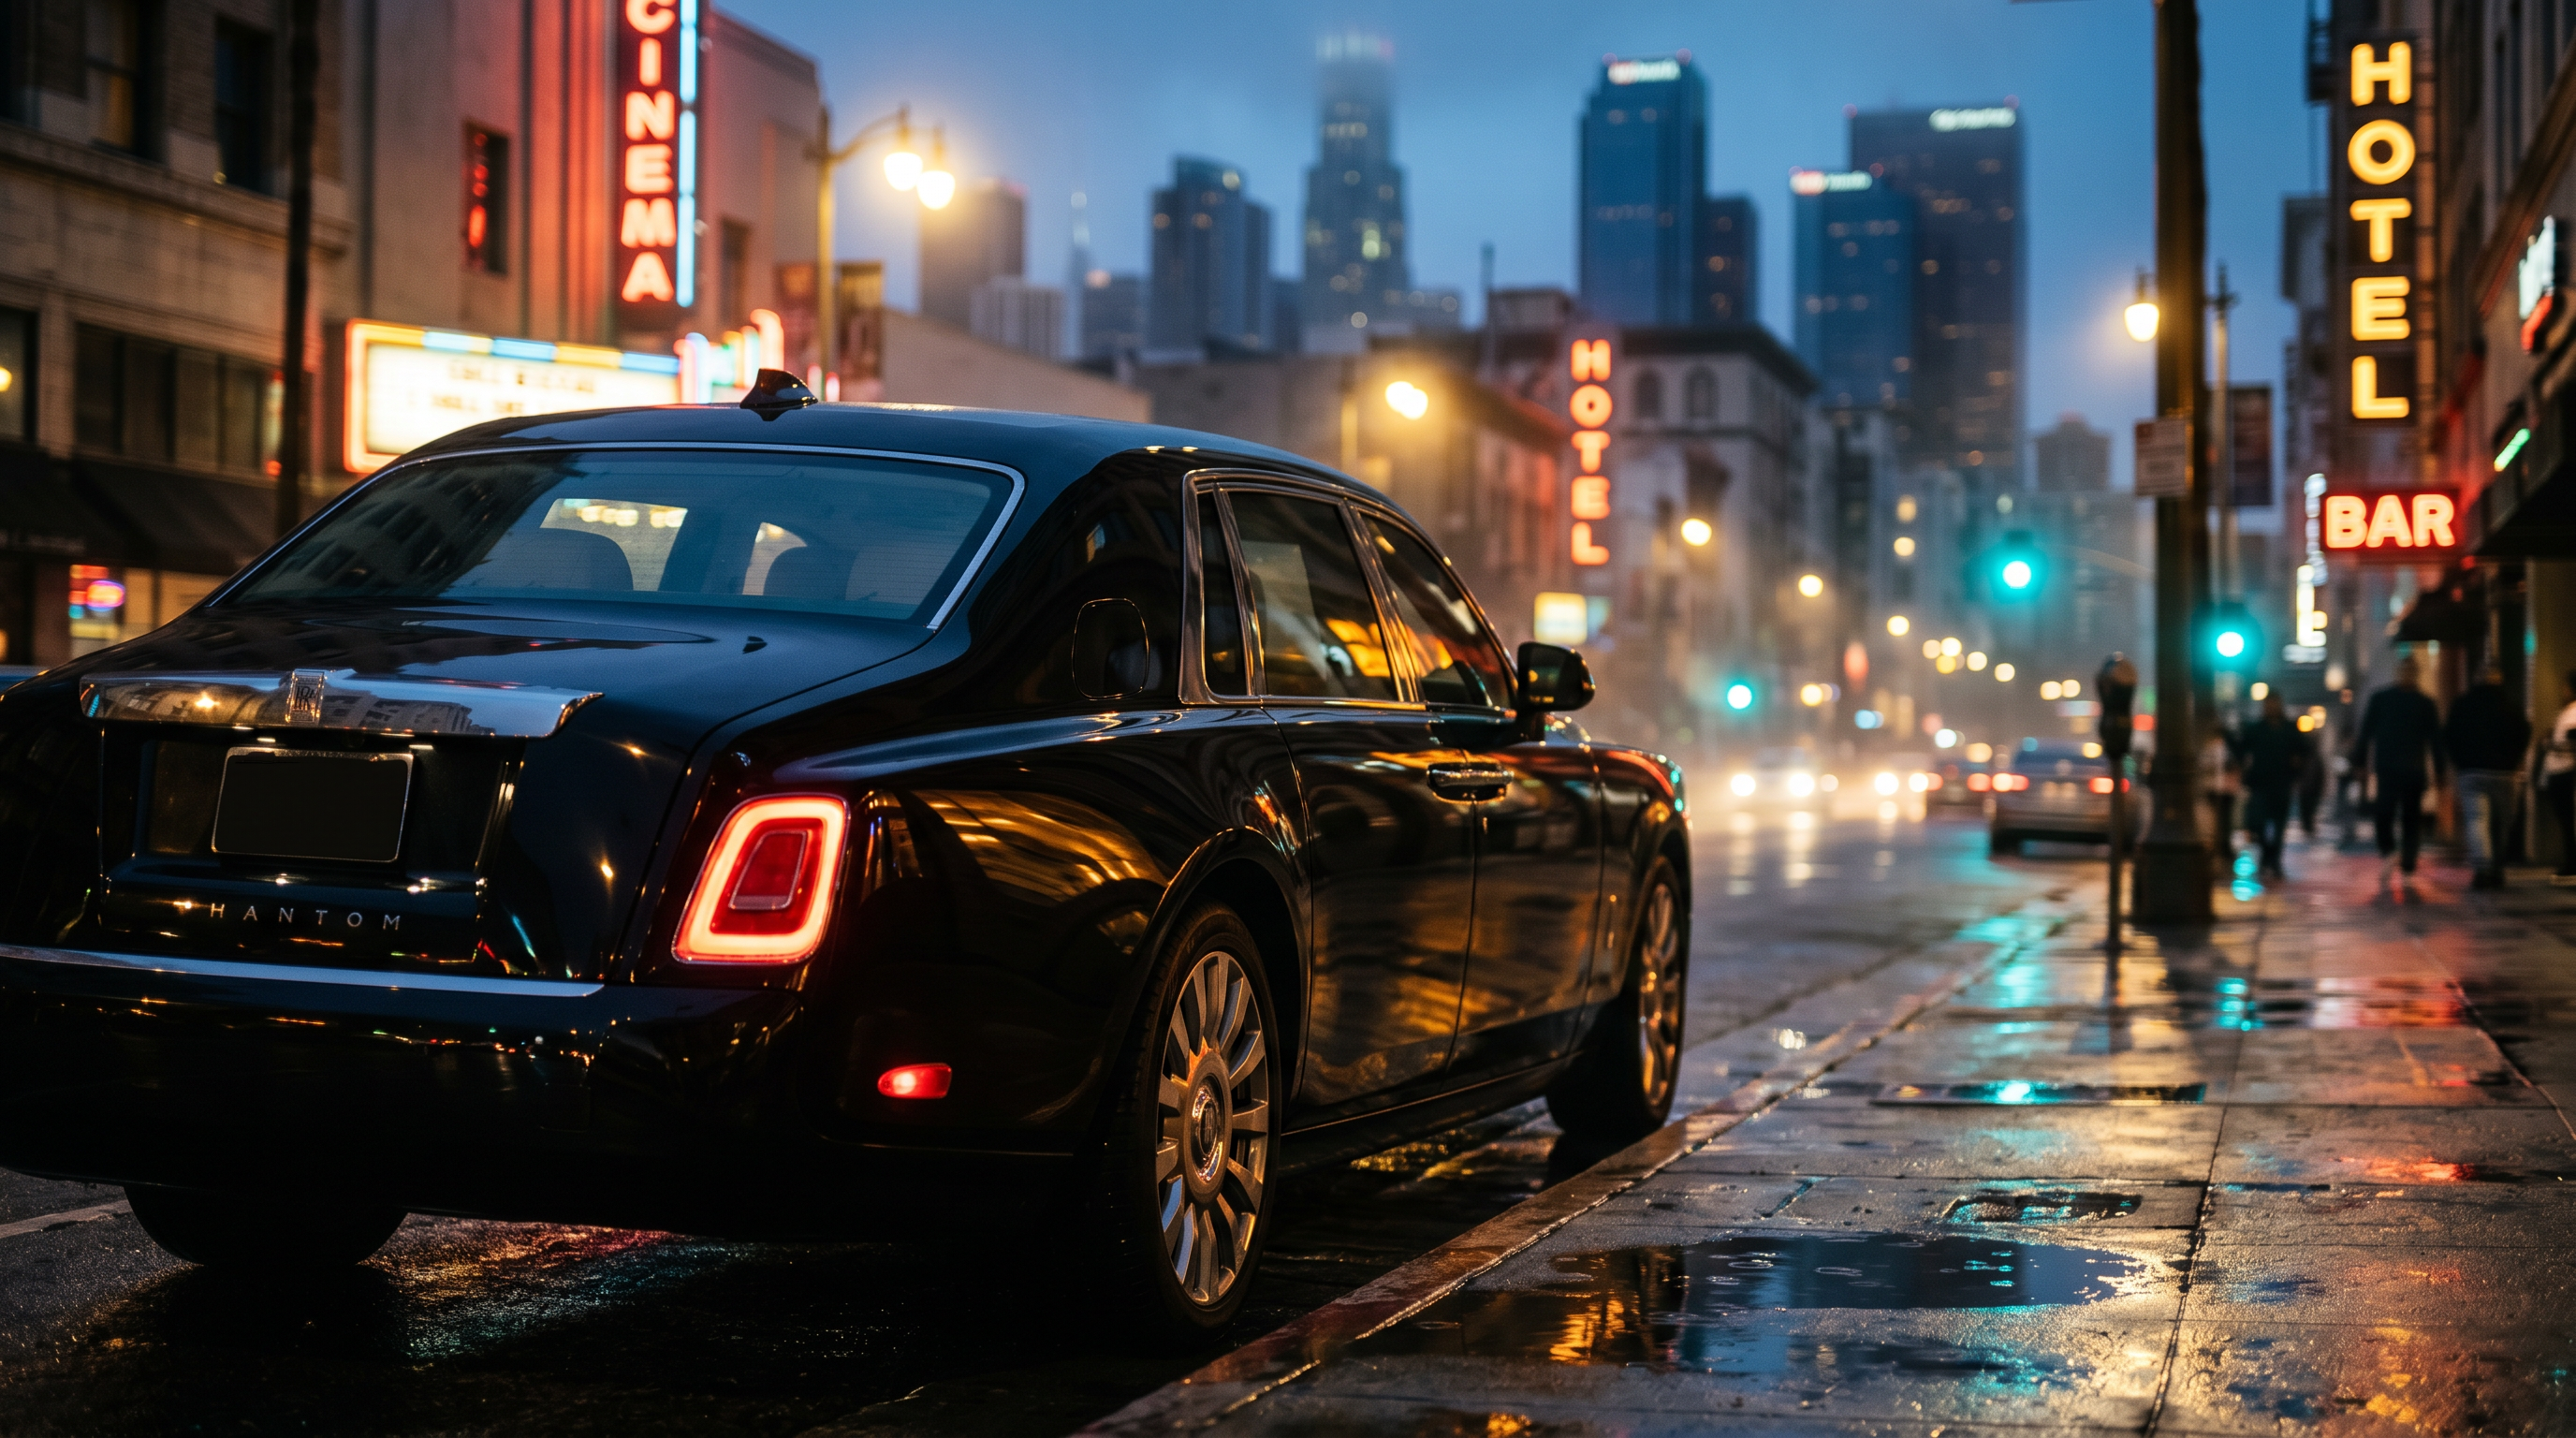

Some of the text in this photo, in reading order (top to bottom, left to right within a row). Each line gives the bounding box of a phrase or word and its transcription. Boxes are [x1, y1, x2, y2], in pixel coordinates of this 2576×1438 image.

[622, 0, 678, 302] CINEMA
[2348, 41, 2415, 419] HOTEL
[1570, 338, 1613, 566] HOTEL
[2325, 493, 2456, 549] BAR
[176, 902, 401, 931] HANTOM
